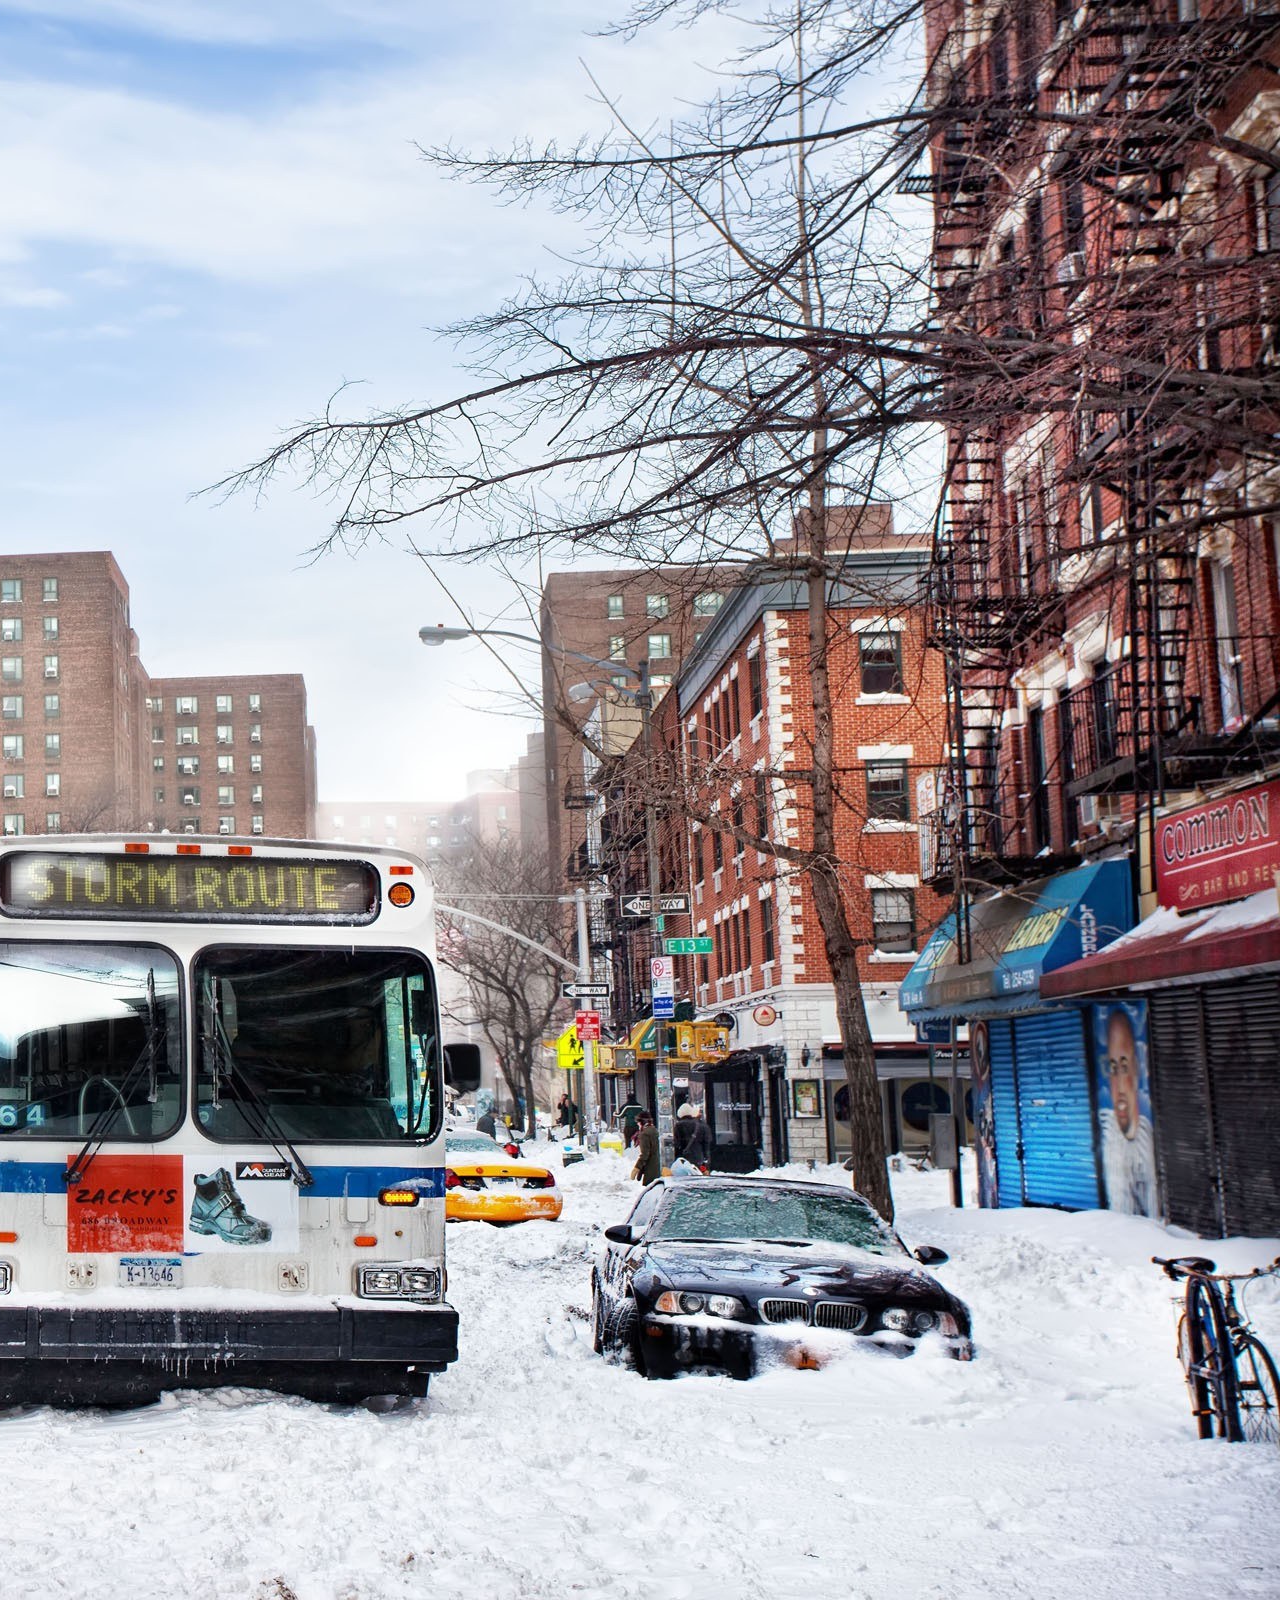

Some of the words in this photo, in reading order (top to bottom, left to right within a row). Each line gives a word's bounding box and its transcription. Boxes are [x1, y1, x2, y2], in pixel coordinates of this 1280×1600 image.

[28, 860, 177, 905] STORM
[195, 866, 339, 909] ROUTE
[1203, 876, 1223, 896] BAR
[1228, 870, 1249, 888] AND
[631, 901, 651, 910] ONE
[660, 900, 680, 909] WAY
[668, 941, 677, 952] E
[681, 940, 696, 952] 13
[75, 1187, 178, 1206] ZACKY'S
[81, 1216, 100, 1225] 686
